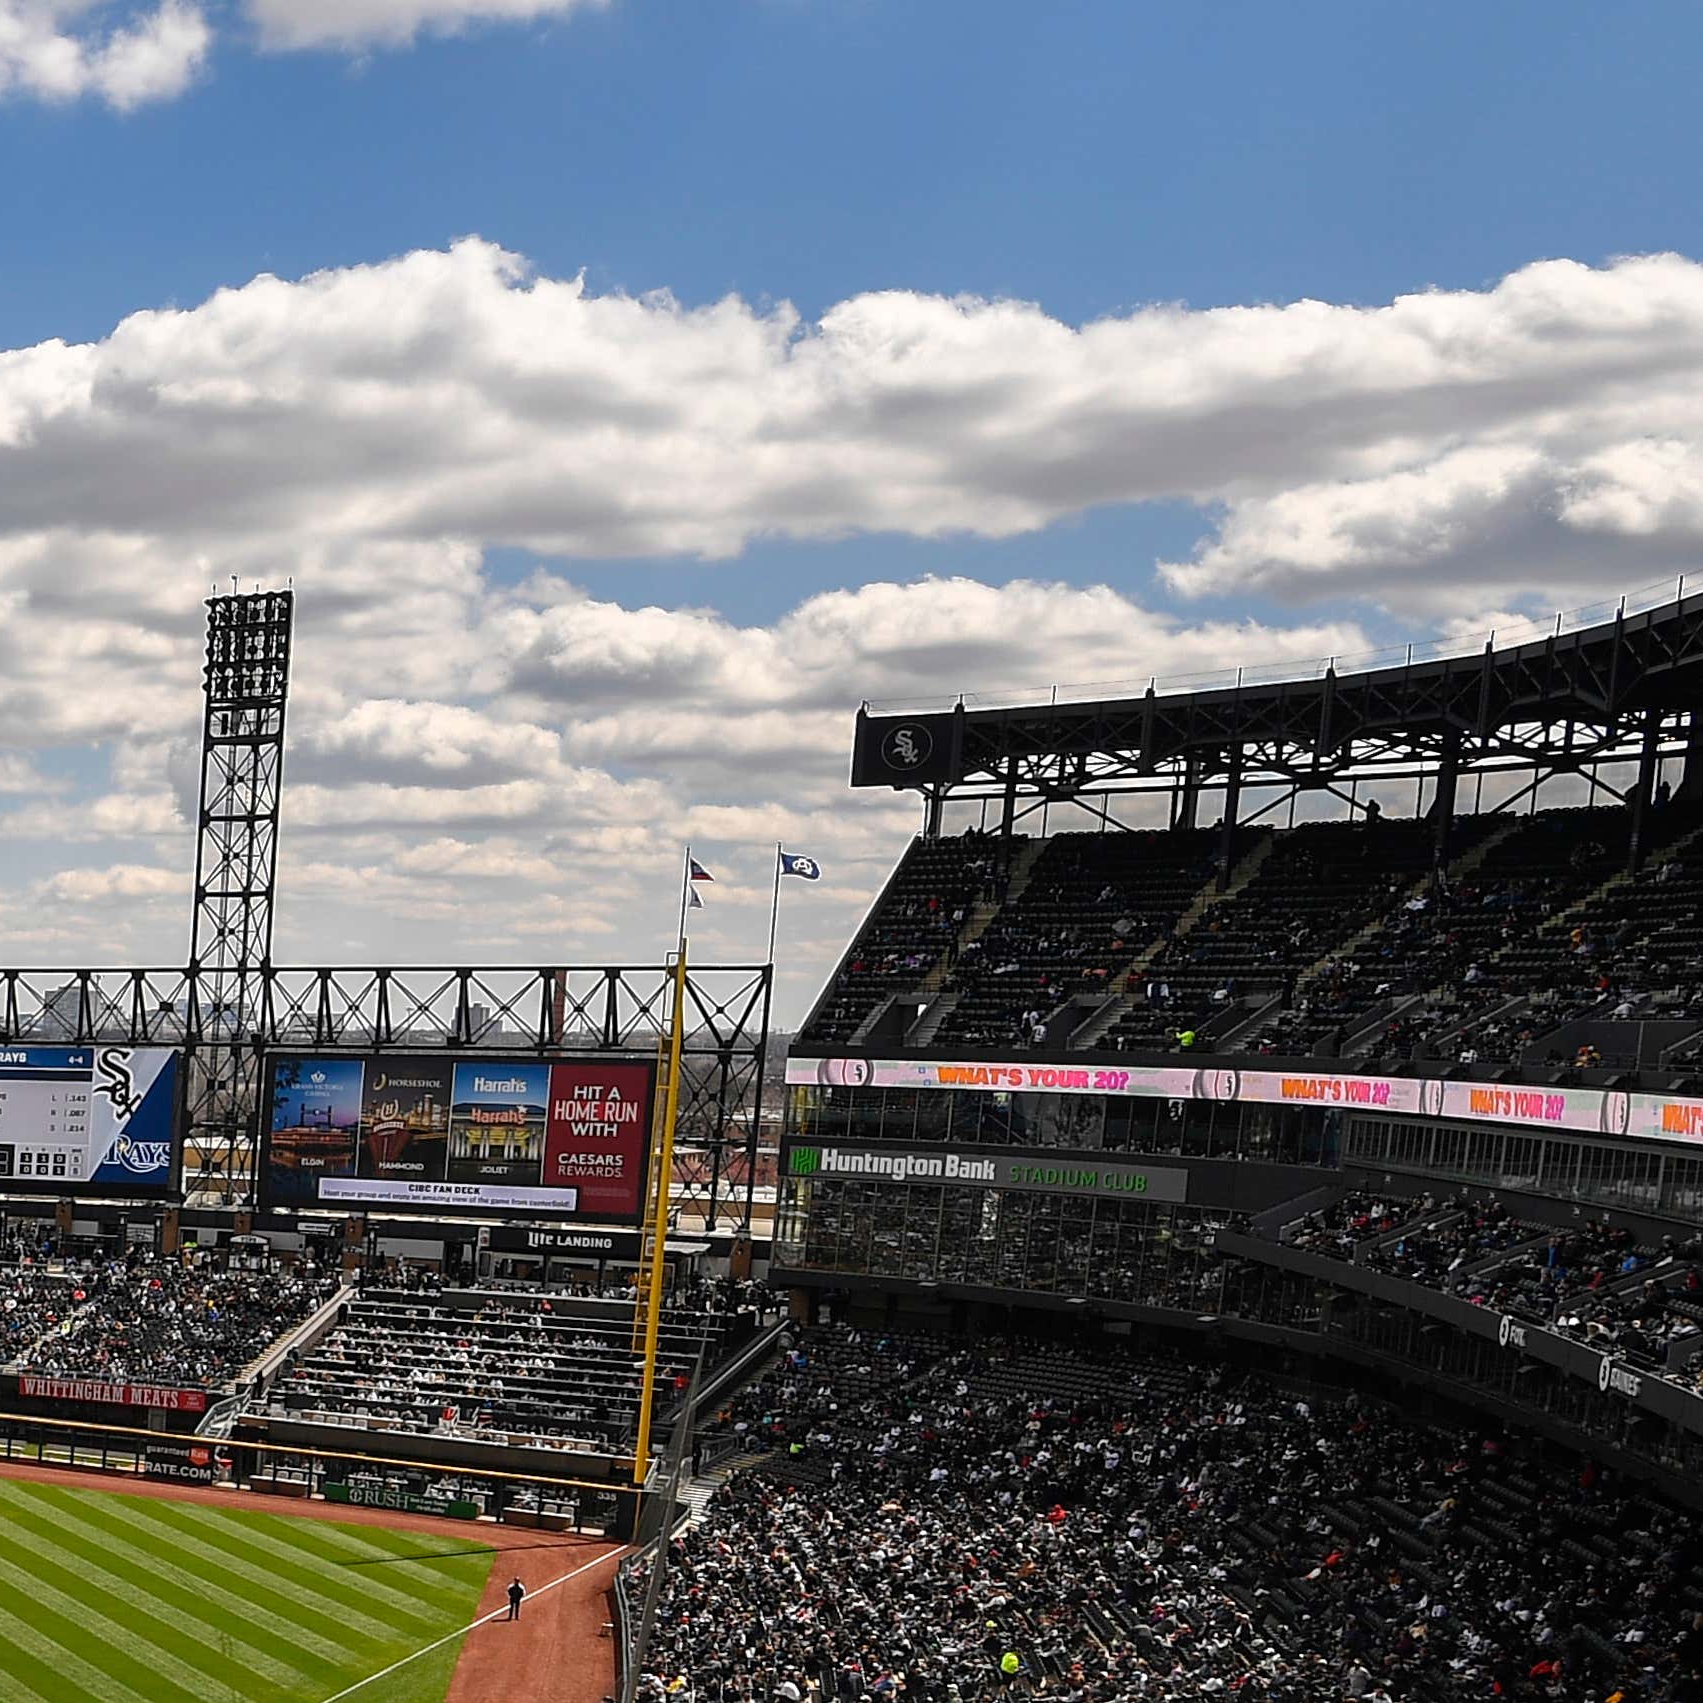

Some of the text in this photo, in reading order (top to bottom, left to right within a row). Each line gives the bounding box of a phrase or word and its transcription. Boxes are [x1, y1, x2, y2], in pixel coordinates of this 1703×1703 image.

[937, 1065, 1131, 1092] WHAT'S YOUR 20?
[574, 1085, 622, 1101] HIT A
[1280, 1077, 1391, 1105] WHAT'S YOUR 20?
[554, 1101, 638, 1124] HOME RUN
[1470, 1088, 1566, 1121] WHAT'S YOUR 20?
[571, 1121, 618, 1139] WITH
[301, 1157, 325, 1167] ELGIN
[379, 1161, 425, 1172] HAMMOND
[558, 1152, 624, 1167] CAESARS
[822, 1148, 997, 1179] Huntington Bank
[479, 1165, 509, 1176] JOLIET
[1010, 1163, 1148, 1193] STADIUM CLUB
[408, 1184, 481, 1196] CIBC FAN DECK
[557, 1235, 613, 1250] LANDING
[24, 1378, 124, 1403] WHITTINGHAM
[130, 1387, 180, 1409] MEATS
[146, 1461, 212, 1480] RATE.COM
[364, 1490, 409, 1510] RUSH
